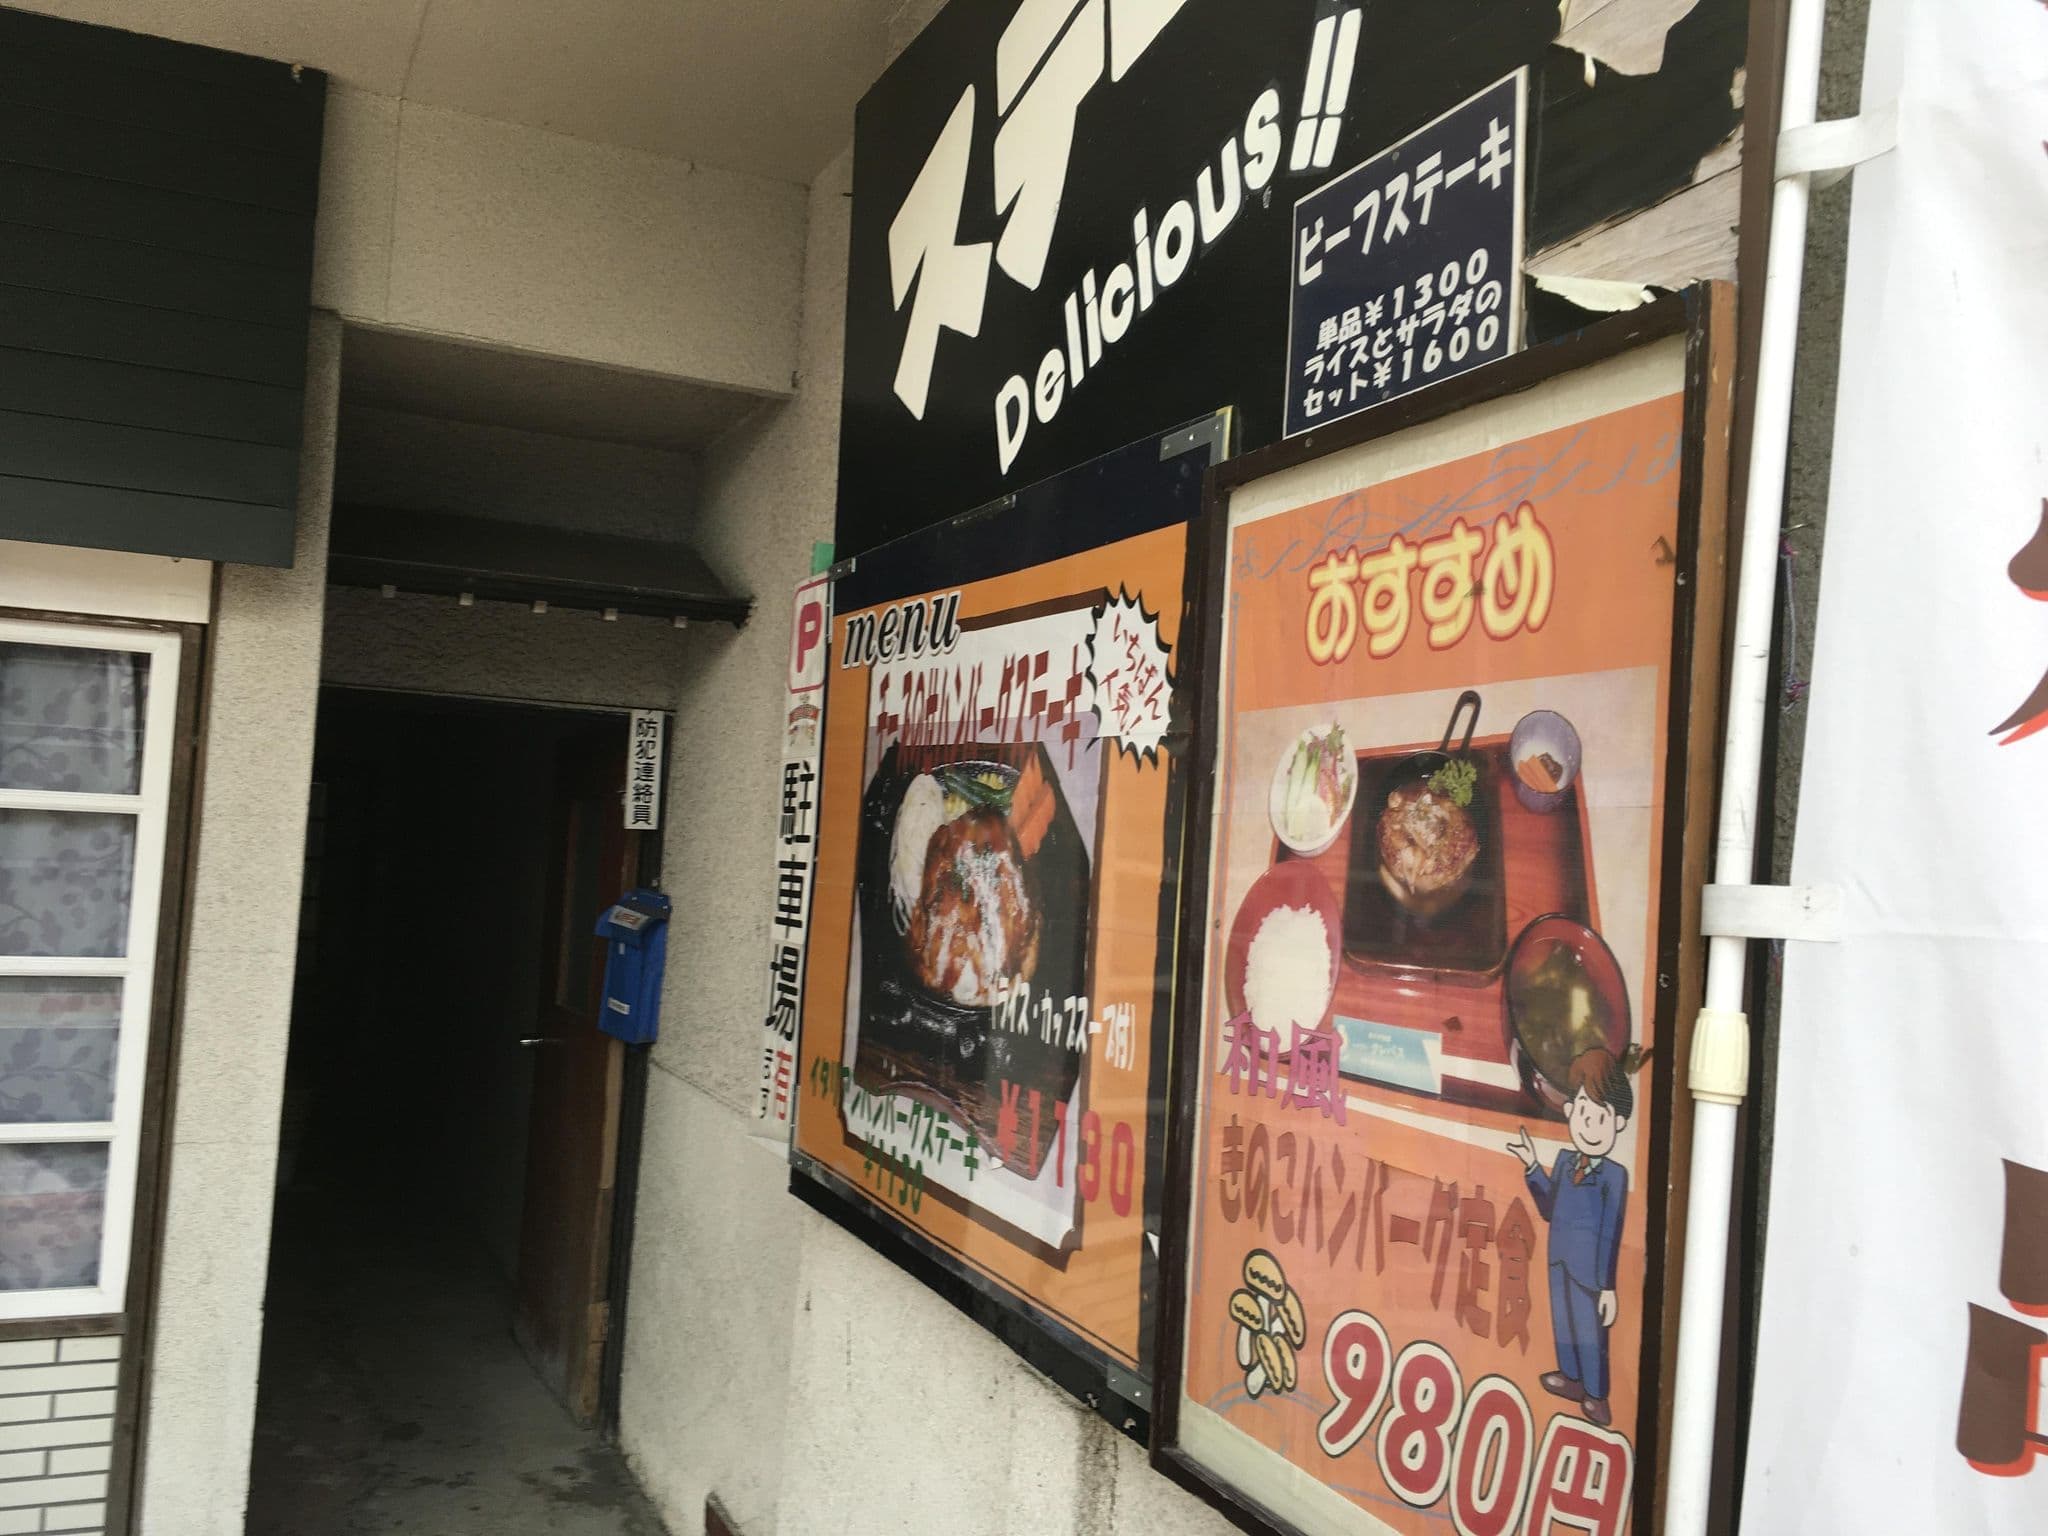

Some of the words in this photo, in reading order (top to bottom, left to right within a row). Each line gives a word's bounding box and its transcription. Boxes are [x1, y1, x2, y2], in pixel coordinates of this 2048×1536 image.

[1297, 116, 1512, 287] ビーフステーキ
[1303, 279, 1503, 385] ライスとサラダの
[796, 600, 823, 674] P
[842, 590, 962, 669] menu
[1304, 498, 1557, 667] おすすめ
[631, 716, 659, 827] 防犯連絡員
[1219, 1008, 1349, 1129] 和風
[1217, 1112, 1538, 1357] きのこハンバーグ定食
[1315, 1307, 1636, 1536] 980円
